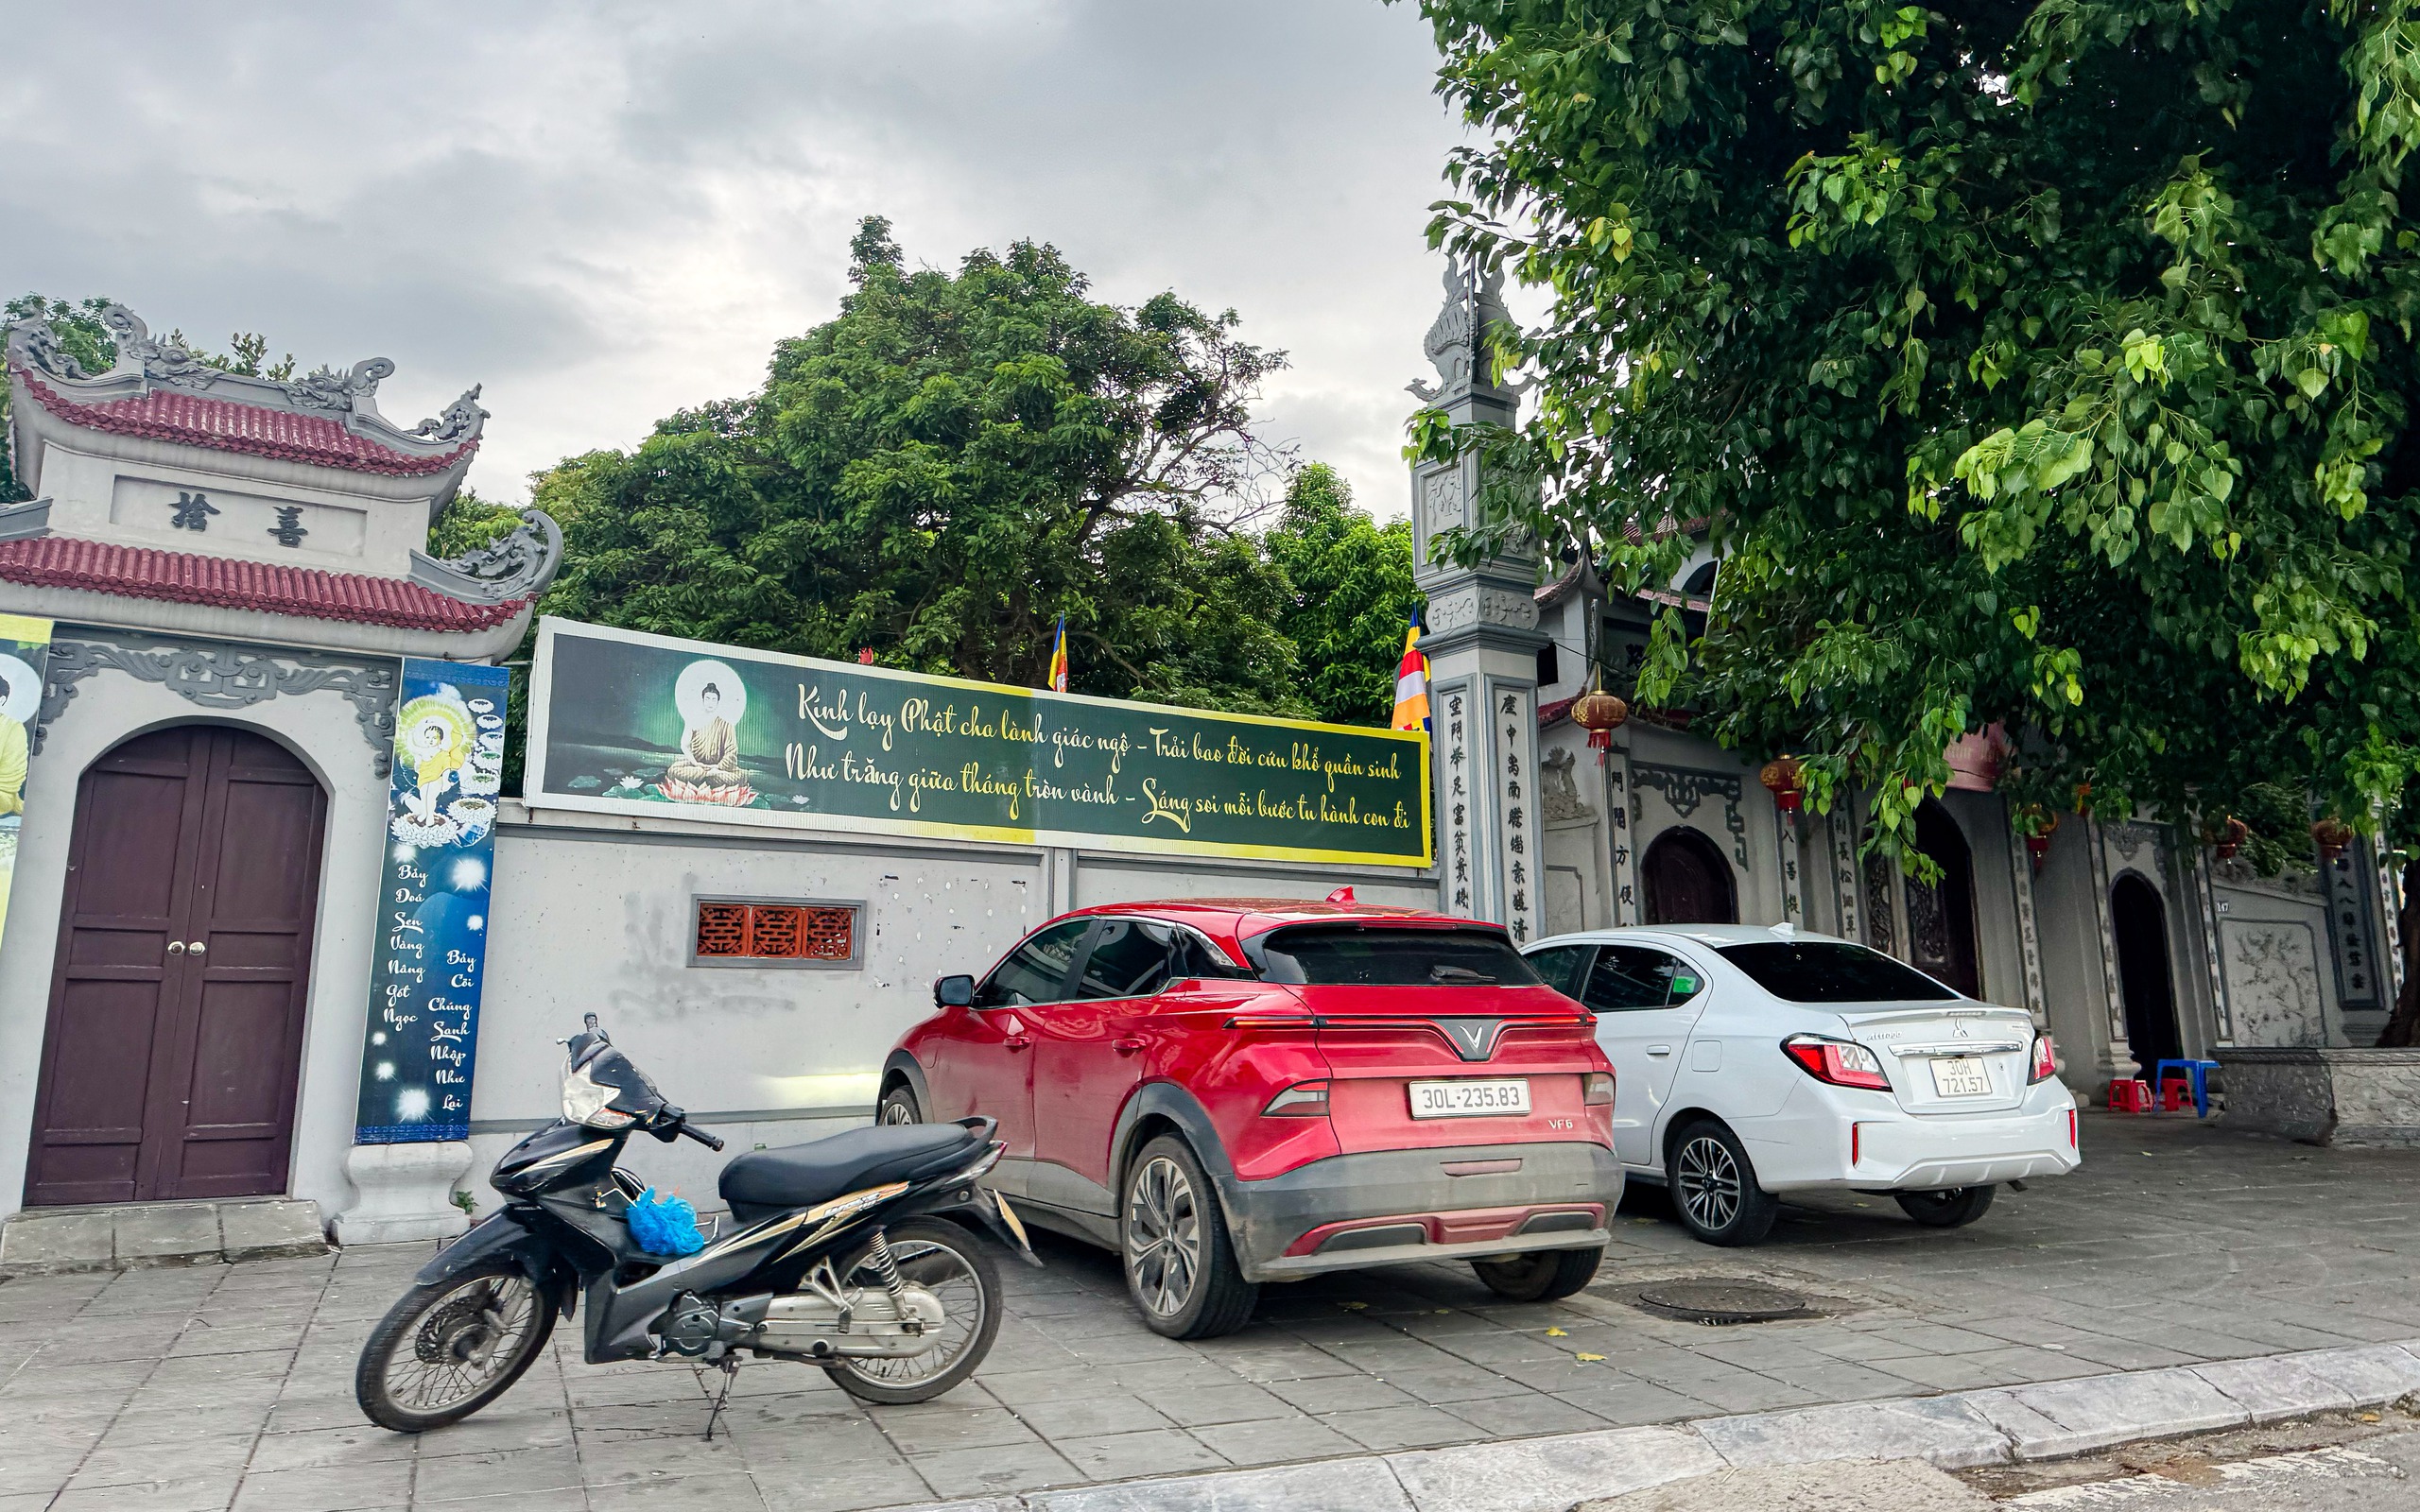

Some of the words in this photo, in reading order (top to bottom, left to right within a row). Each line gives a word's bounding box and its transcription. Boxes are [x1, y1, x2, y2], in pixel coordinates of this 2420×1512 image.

[798, 683, 854, 741] Kính
[858, 691, 896, 752] lạy
[901, 697, 957, 737] Phật
[959, 705, 997, 738] cha
[1001, 710, 1048, 744] lành
[1052, 727, 1094, 768] giác
[1098, 732, 1132, 774] ngộ
[1150, 727, 1190, 759] Trải
[1193, 731, 1224, 763] bao
[1227, 734, 1255, 765] đời
[1257, 750, 1288, 768] cứu
[1291, 742, 1322, 772] khổ
[1324, 753, 1365, 793] quần
[1367, 752, 1402, 780] sinh
[785, 742, 839, 781] Như
[840, 749, 905, 812] trăng
[908, 767, 959, 813] giữa
[959, 761, 1023, 820] tháng
[1023, 768, 1068, 800] tròn
[1070, 774, 1119, 805] vành
[1141, 777, 1193, 833] Sáng
[1195, 795, 1221, 814] soi
[1223, 792, 1255, 816] mỗi
[1257, 789, 1296, 819] bước
[1296, 794, 1318, 821] tu
[1321, 794, 1360, 825] hành
[1363, 812, 1391, 828] con
[1393, 800, 1411, 829] đi
[398, 864, 429, 888] Bảy
[391, 911, 424, 935] Sen
[390, 935, 425, 960] Vàng
[388, 959, 426, 984] Nâng
[446, 949, 477, 973] Bảy
[451, 974, 475, 988] Cõi
[383, 1007, 419, 1032] Ngọc
[427, 997, 473, 1021] Chúng
[430, 1021, 471, 1043] Sanh
[430, 1045, 467, 1068] Nhập
[1946, 1059, 1973, 1076] 30H
[435, 1069, 466, 1085] Như
[1943, 1076, 1984, 1094] 721.57
[442, 1094, 464, 1111] Lai
